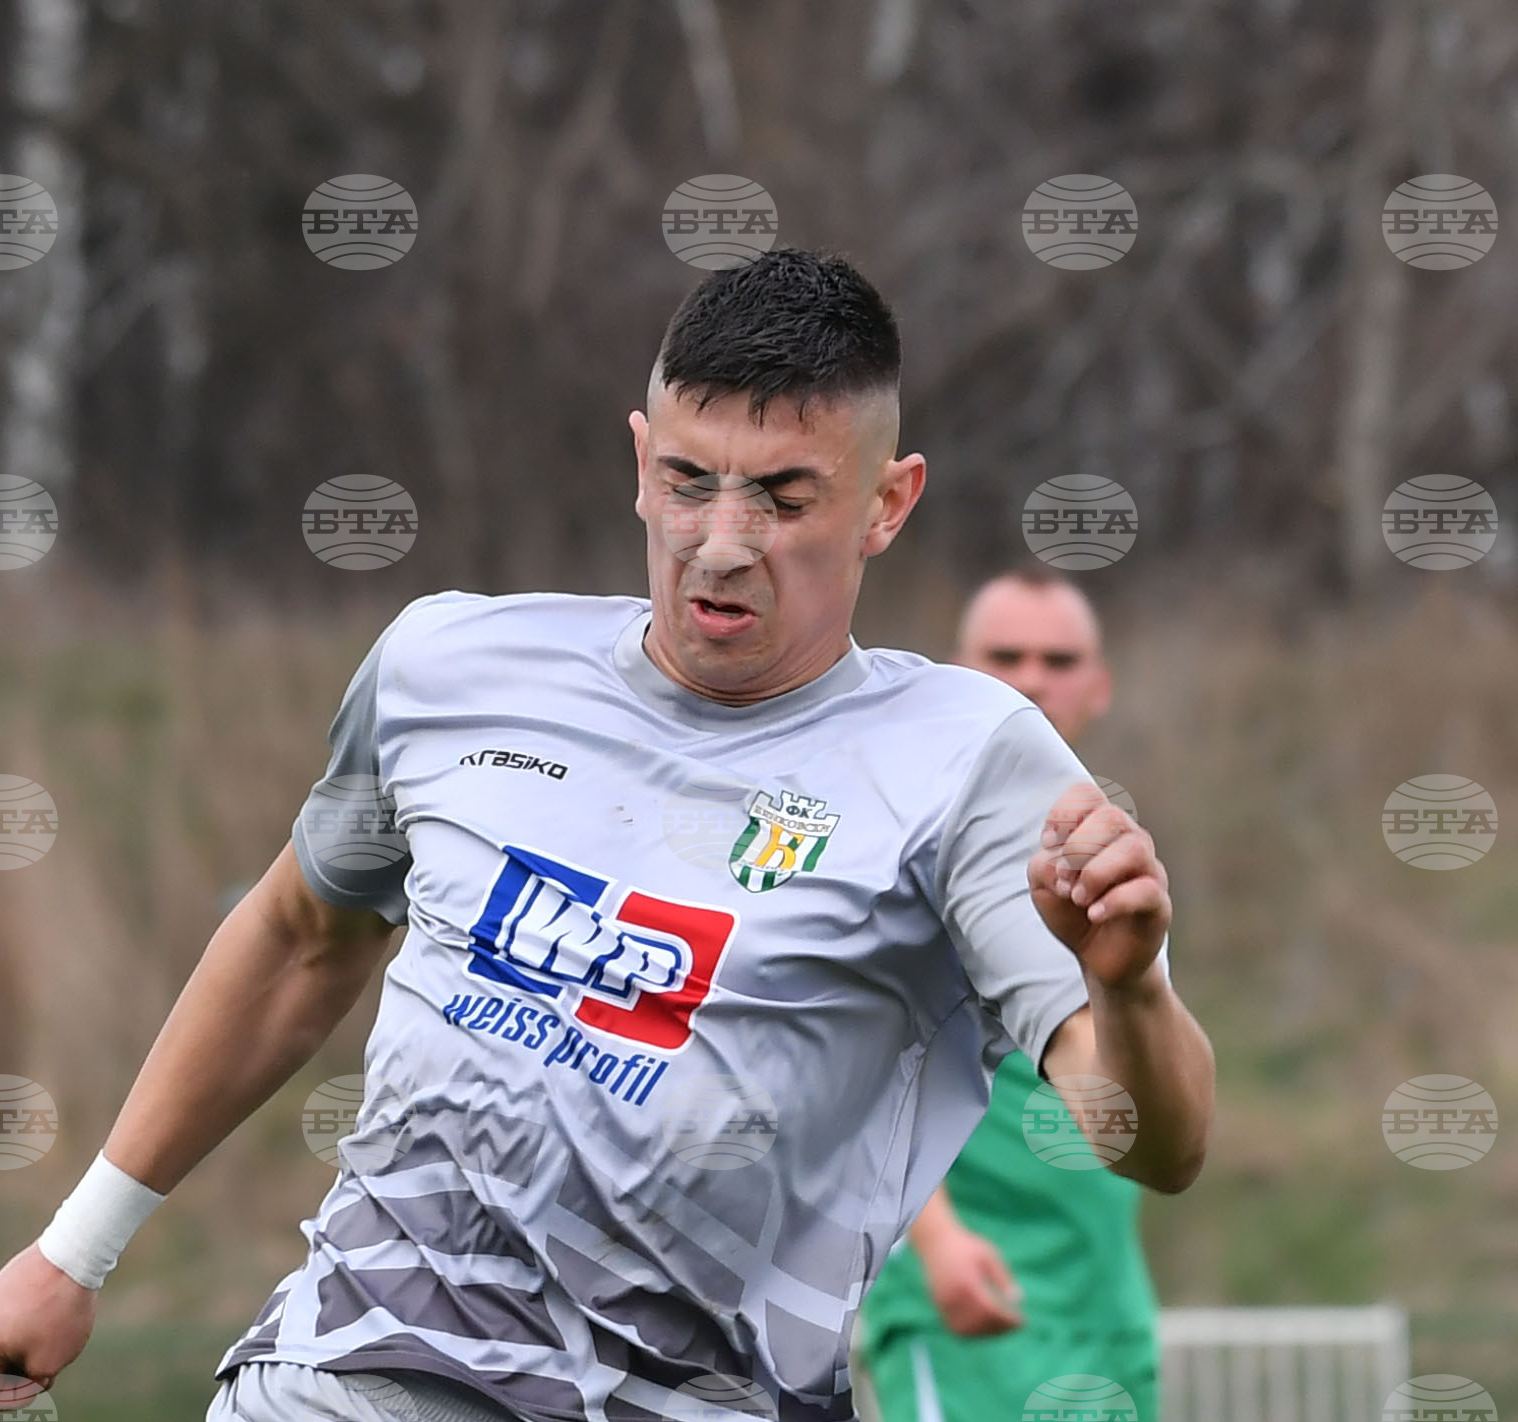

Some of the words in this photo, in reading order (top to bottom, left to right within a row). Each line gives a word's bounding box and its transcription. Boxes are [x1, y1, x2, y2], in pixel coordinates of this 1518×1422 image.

[785, 804, 813, 819] ФК
[443, 994, 561, 1051] weiss
[543, 1026, 670, 1107] profil
